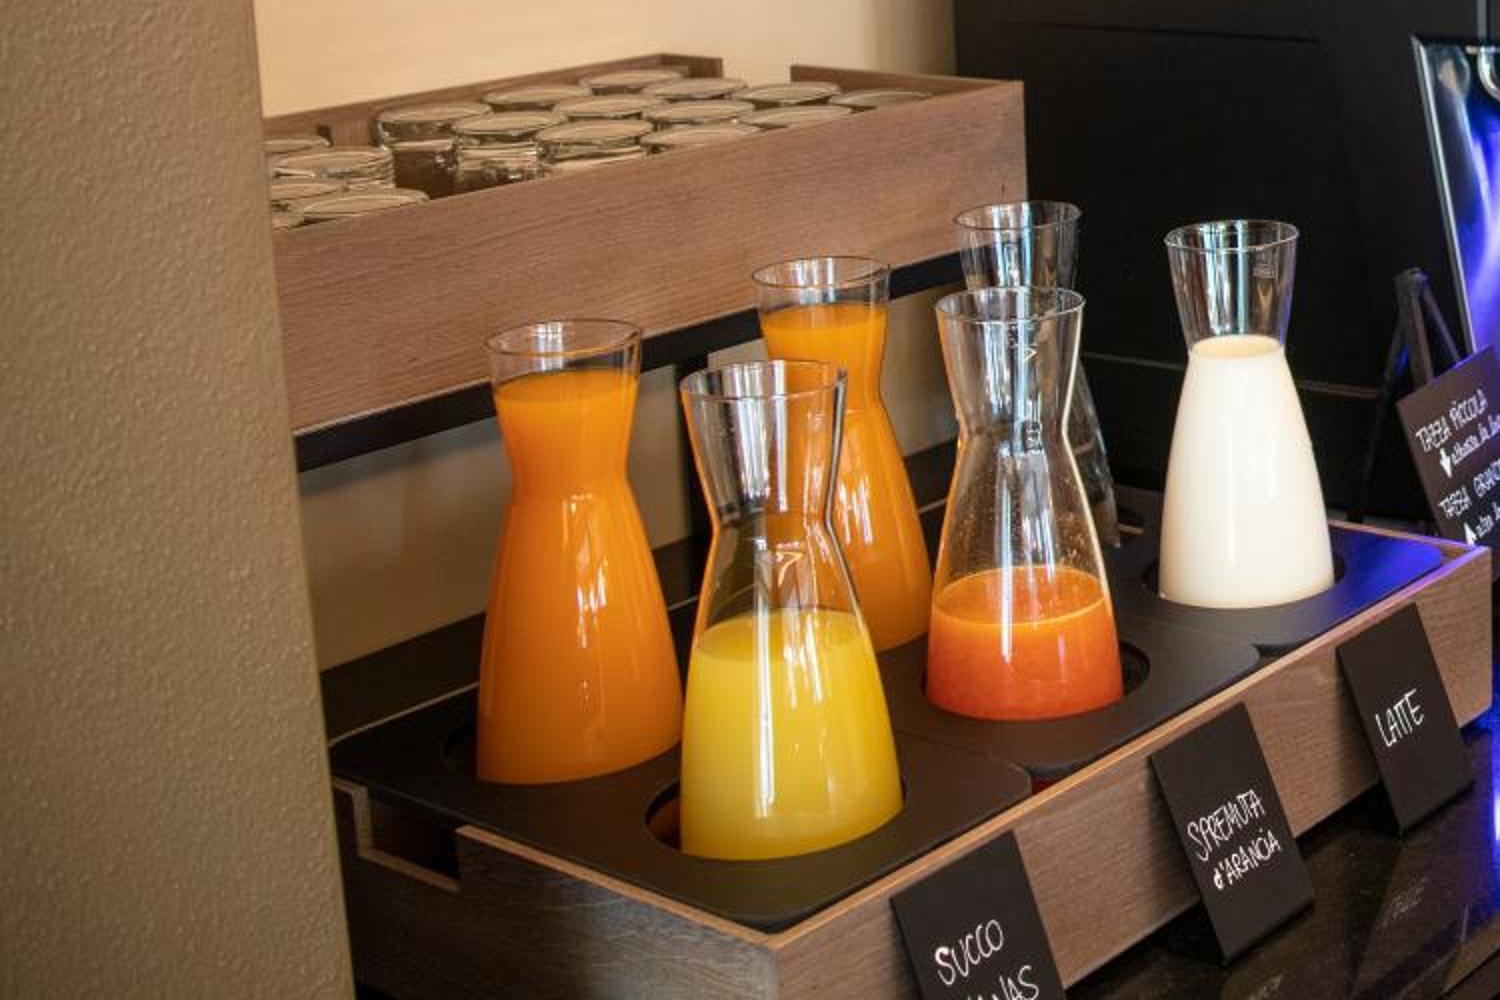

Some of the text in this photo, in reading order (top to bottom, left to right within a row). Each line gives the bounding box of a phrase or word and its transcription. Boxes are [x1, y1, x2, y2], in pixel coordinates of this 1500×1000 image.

[1375, 688, 1424, 747] LATTE
[1187, 789, 1266, 861] SPREMUTA
[935, 919, 1004, 985] SUCCO
